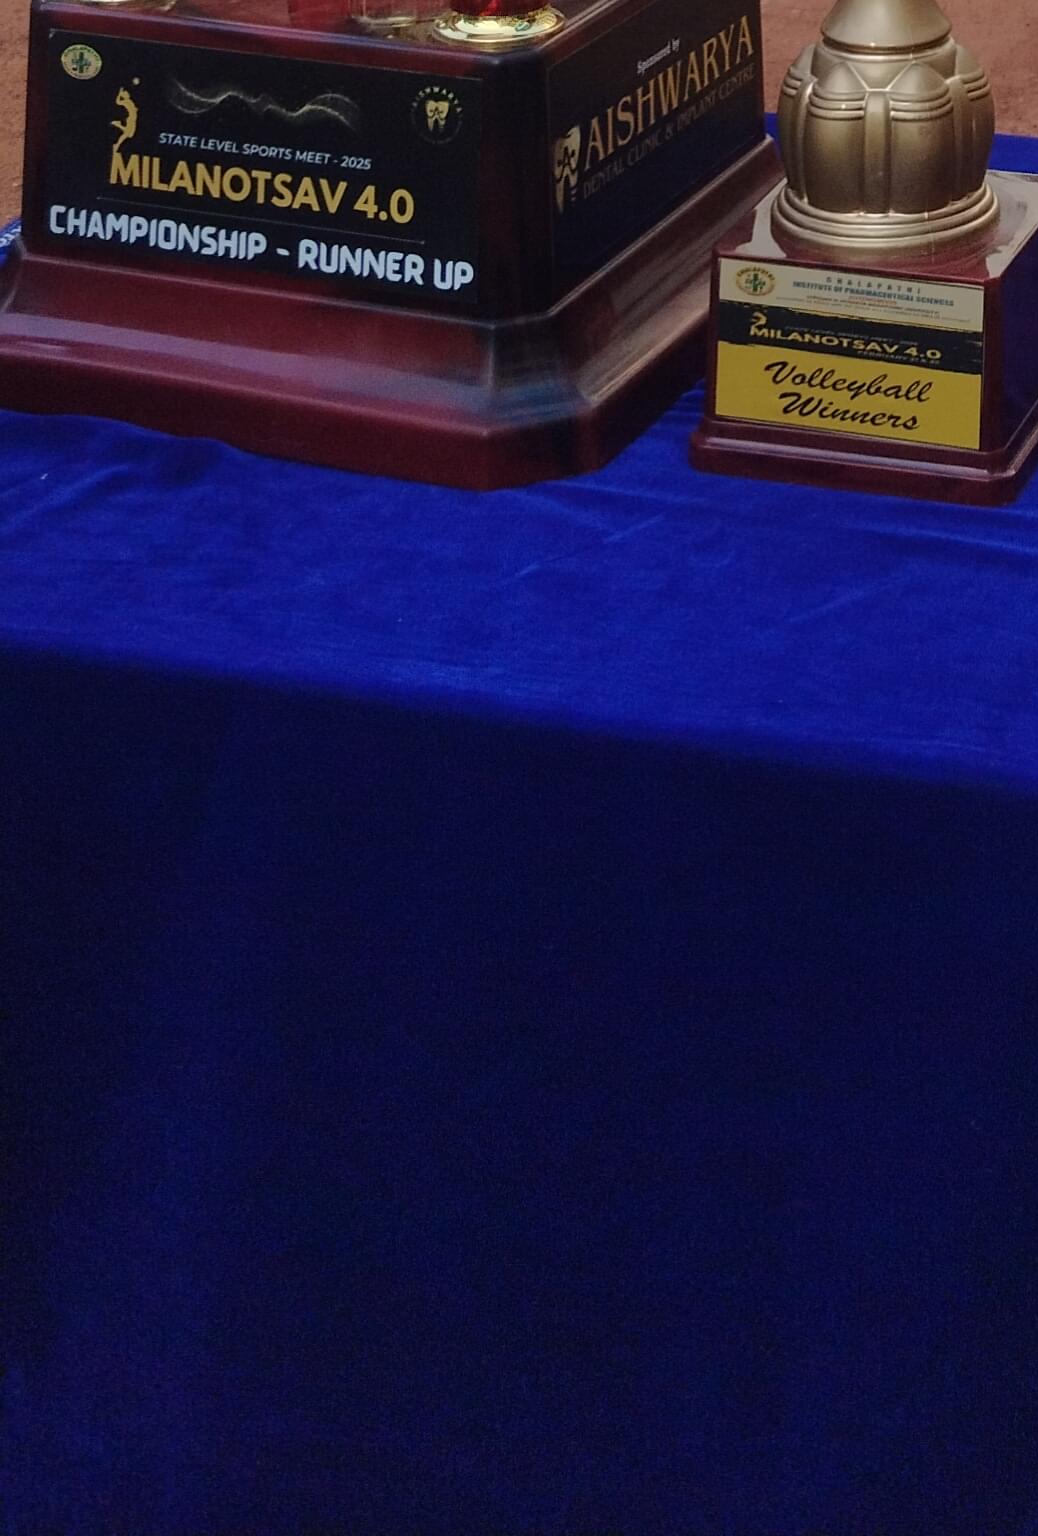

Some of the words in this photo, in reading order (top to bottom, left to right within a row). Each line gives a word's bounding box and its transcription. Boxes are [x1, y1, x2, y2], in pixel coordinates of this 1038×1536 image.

[584, 14, 754, 172] AISHWARYA
[158, 131, 198, 148] STATE
[200, 137, 239, 154] LEVEL
[242, 143, 292, 161] SPORTS
[295, 149, 331, 166] MEET
[340, 155, 372, 170] 2025
[109, 150, 348, 215] MILANOTSAV
[353, 184, 415, 225] 4.0
[49, 204, 268, 261] CHAMPIONSHIP
[276, 247, 290, 257] -
[298, 238, 425, 286] RUNNER
[433, 258, 474, 291] UP
[750, 326, 899, 355] MILANOTSAV
[903, 343, 942, 360] 4.0
[764, 360, 934, 403] Volleyball
[778, 391, 920, 431] Winners
